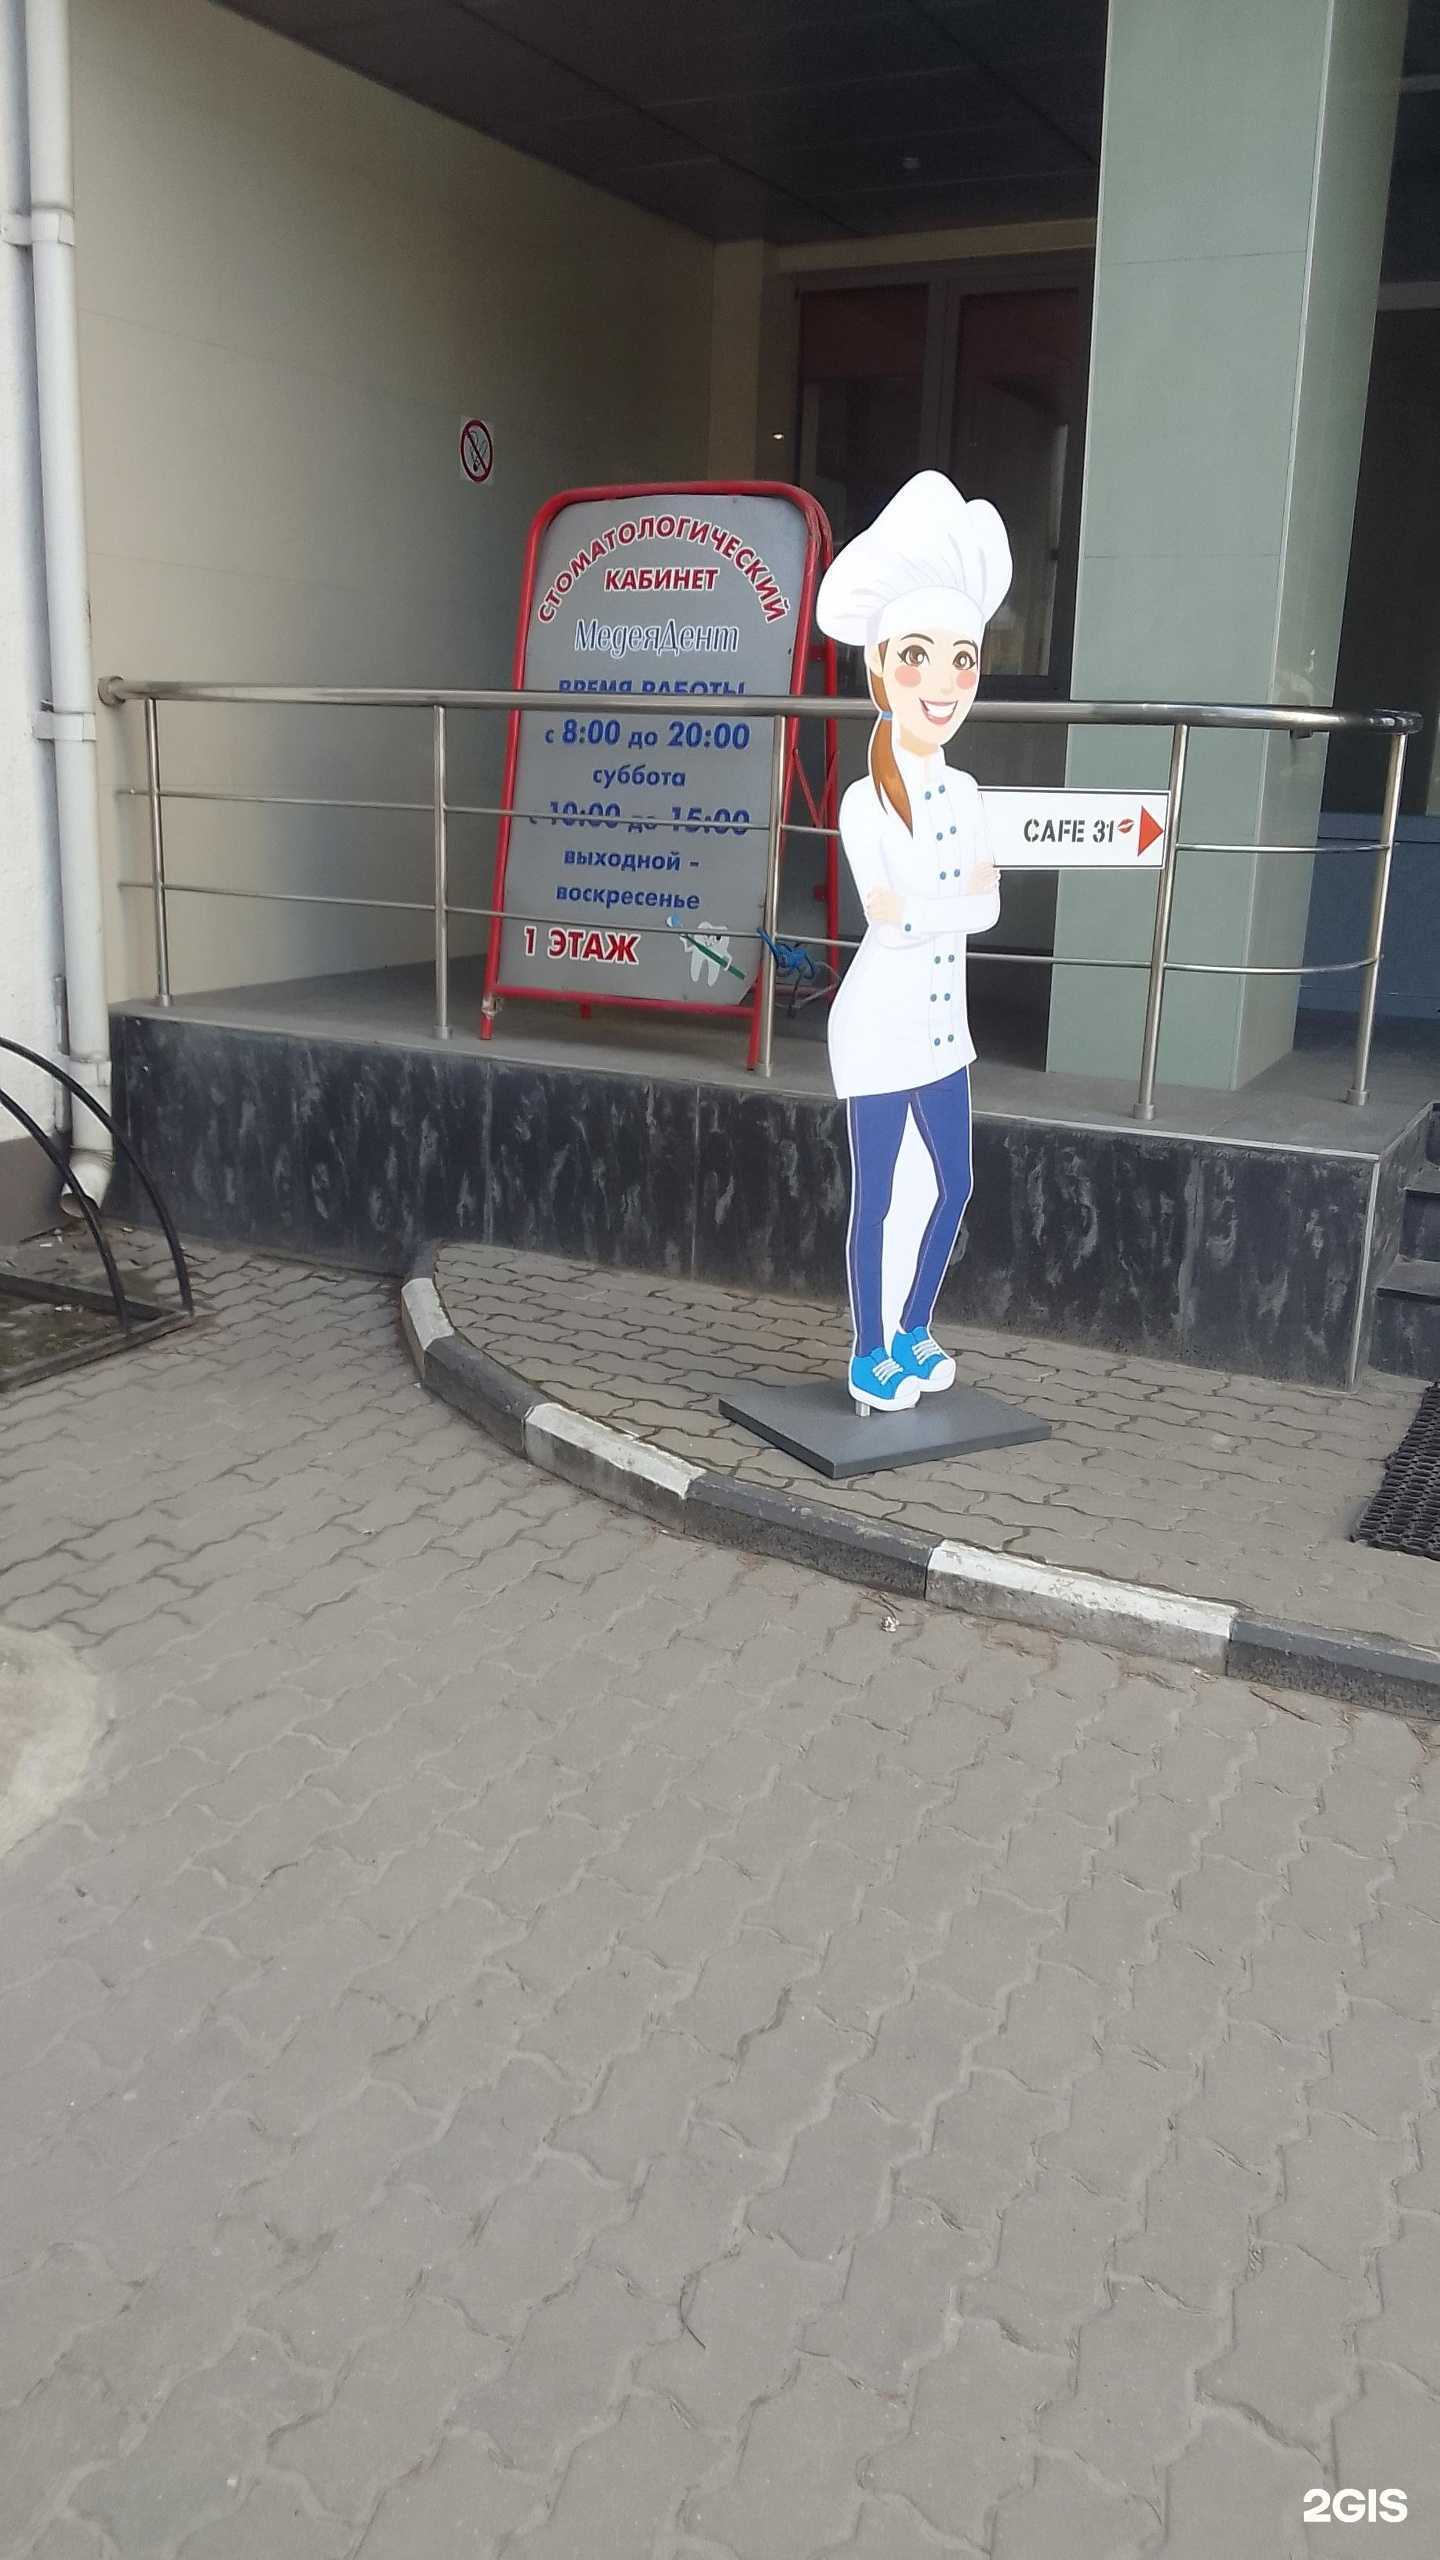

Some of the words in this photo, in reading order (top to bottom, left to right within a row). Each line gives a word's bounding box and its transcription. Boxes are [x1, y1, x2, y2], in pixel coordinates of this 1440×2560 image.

[538, 515, 791, 624] СТОМАТОЛОГИЧЕСКИЙ
[604, 567, 720, 591] КАБИНЕТ
[574, 617, 740, 659] МедеяДент
[545, 730, 554, 744] с
[562, 718, 621, 745] 8:00
[628, 731, 659, 749] до
[667, 721, 751, 750] 20:00
[592, 764, 686, 789] суббота
[1023, 818, 1086, 843] CAFE
[1092, 819, 1115, 844] 31
[563, 849, 681, 873] выходной
[556, 885, 701, 910] воскресенье
[524, 926, 538, 957] 1
[547, 928, 642, 965] ЭТАЖ
